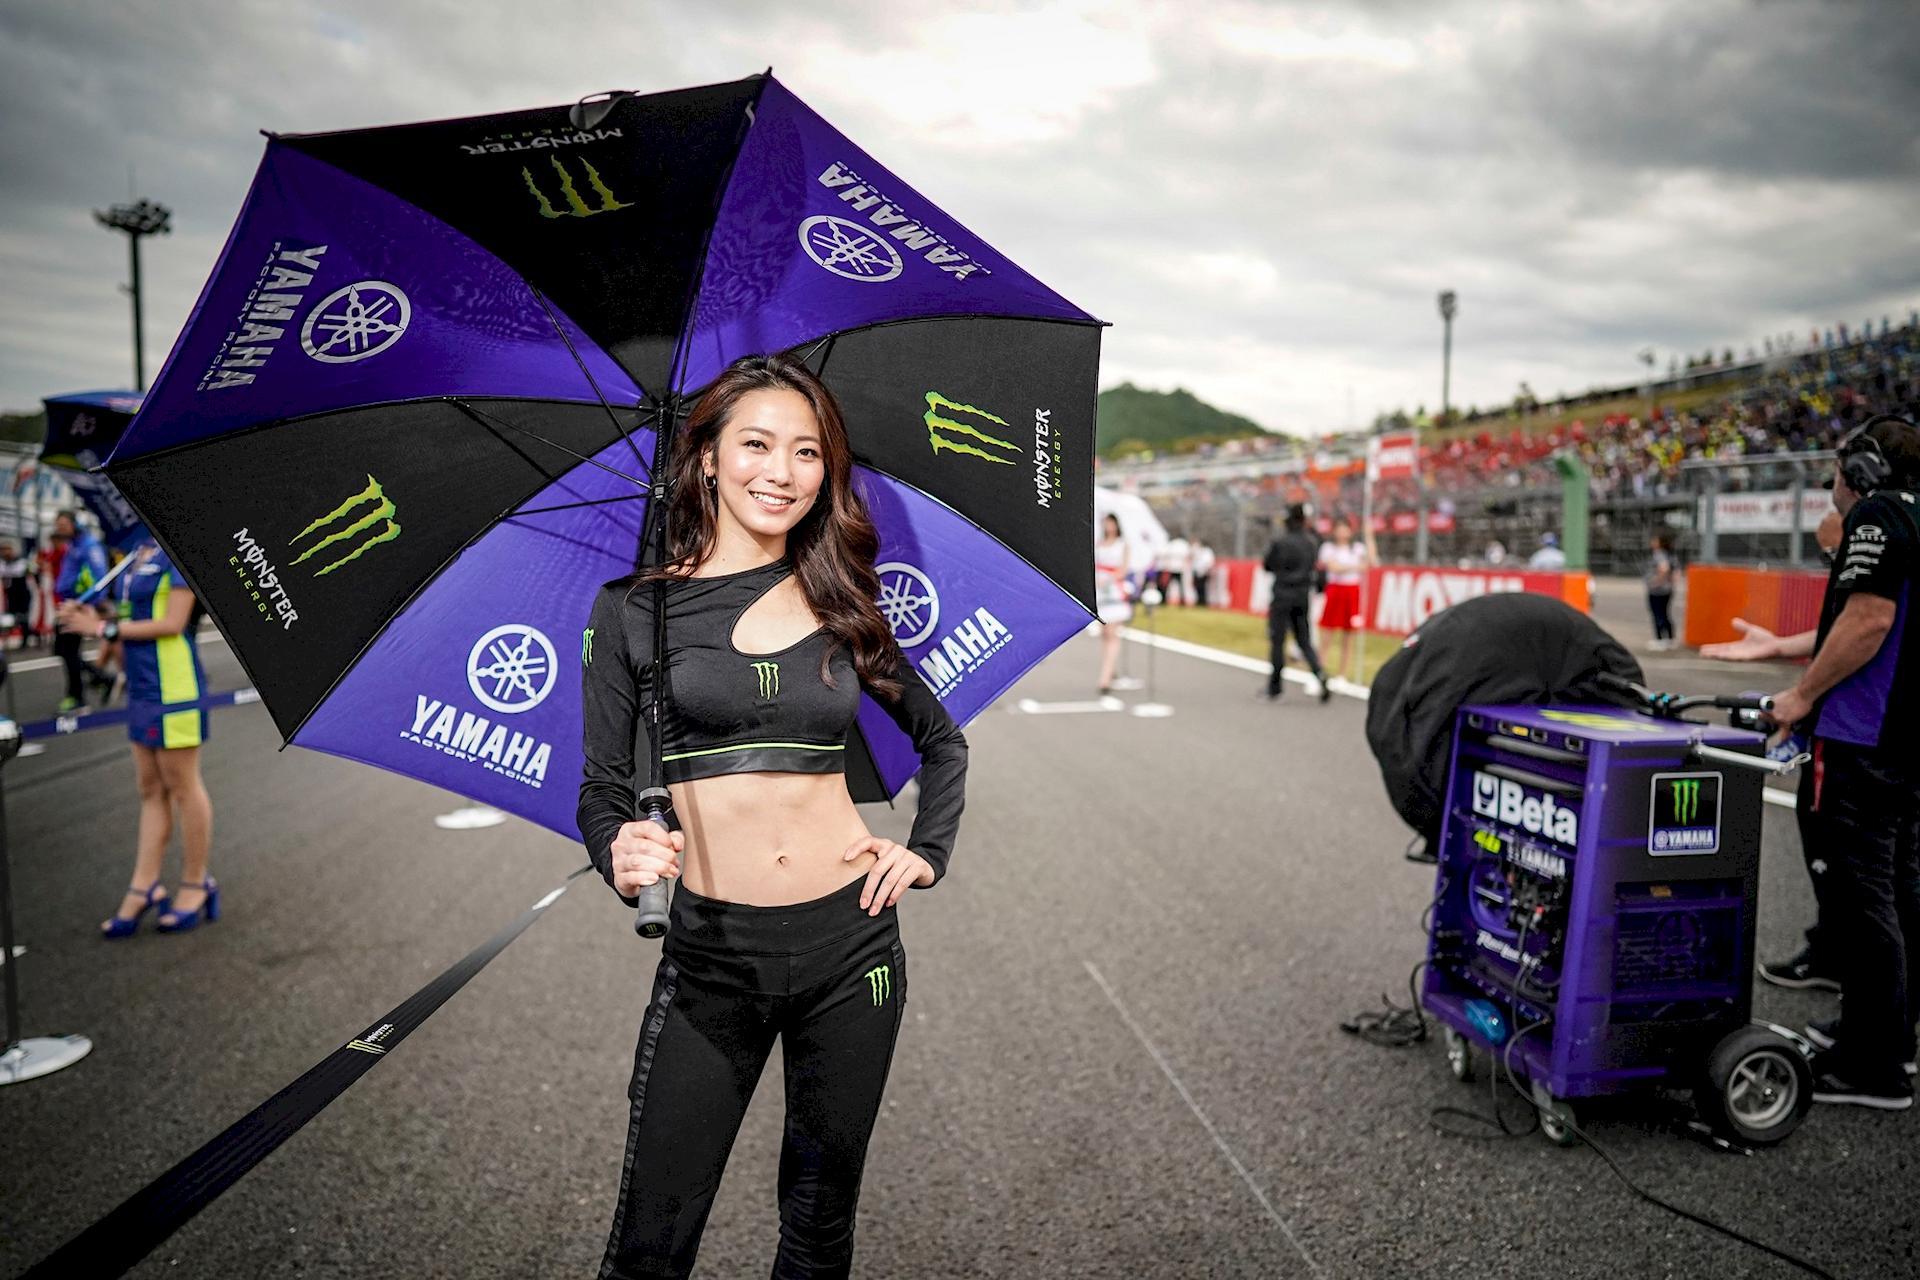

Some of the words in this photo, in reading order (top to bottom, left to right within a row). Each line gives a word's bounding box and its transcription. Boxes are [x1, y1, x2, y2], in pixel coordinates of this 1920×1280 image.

[460, 127, 624, 155] MONSTER
[482, 126, 574, 142] NERGY
[817, 163, 978, 281] YAMAHA
[236, 241, 281, 323] FACTORY
[206, 245, 328, 390] YAMAHA
[196, 331, 236, 391] RACING
[1032, 408, 1052, 508] MONSTER
[229, 555, 273, 621] ENERGY
[233, 527, 299, 630] MONSTER
[914, 606, 1008, 695] MAHA
[967, 633, 1013, 674] RACING
[400, 731, 477, 763] FACTORY
[483, 761, 542, 789] RACING
[411, 694, 552, 781] YAMAHA
[1498, 779, 1577, 846] Beta
[1668, 829, 1714, 847] YAMAHA
